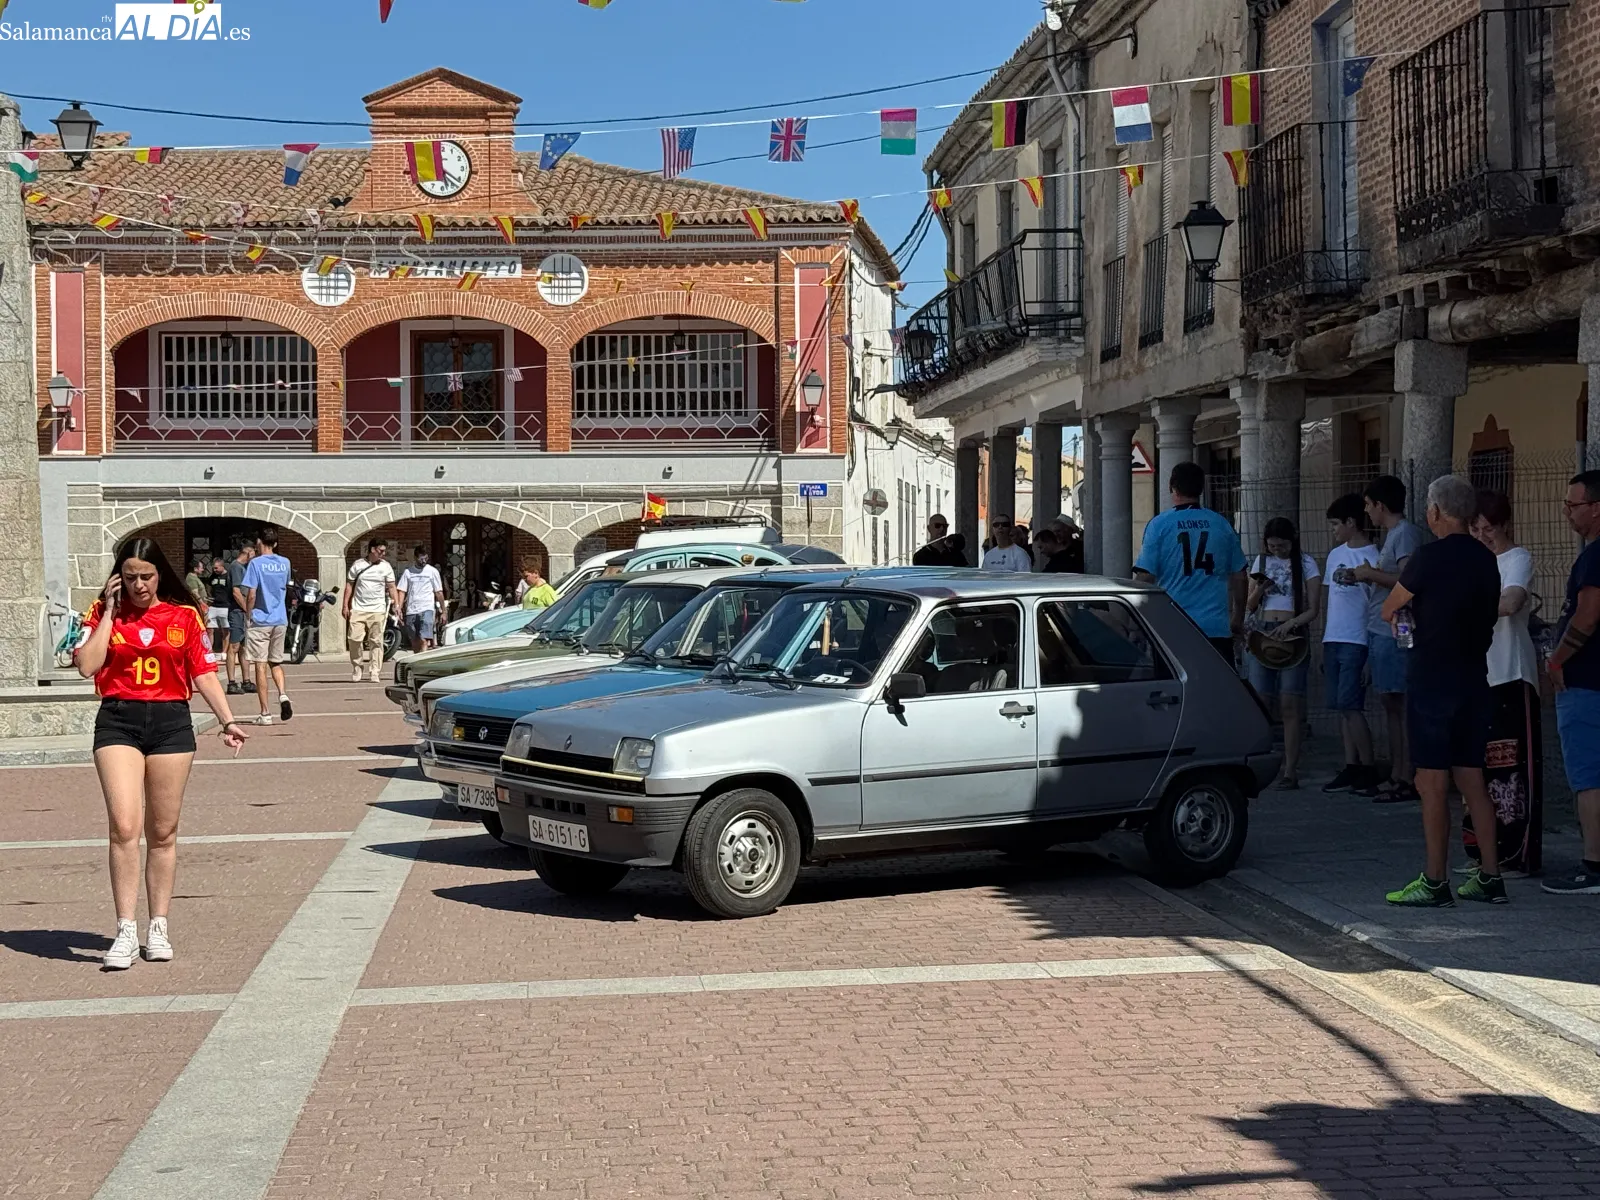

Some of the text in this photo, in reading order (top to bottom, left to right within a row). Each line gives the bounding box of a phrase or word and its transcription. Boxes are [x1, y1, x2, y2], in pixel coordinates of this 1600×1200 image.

[1177, 520, 1210, 530] ALONSO
[1177, 530, 1215, 577] 14
[261, 563, 287, 572] POLO
[132, 656, 161, 685] 19
